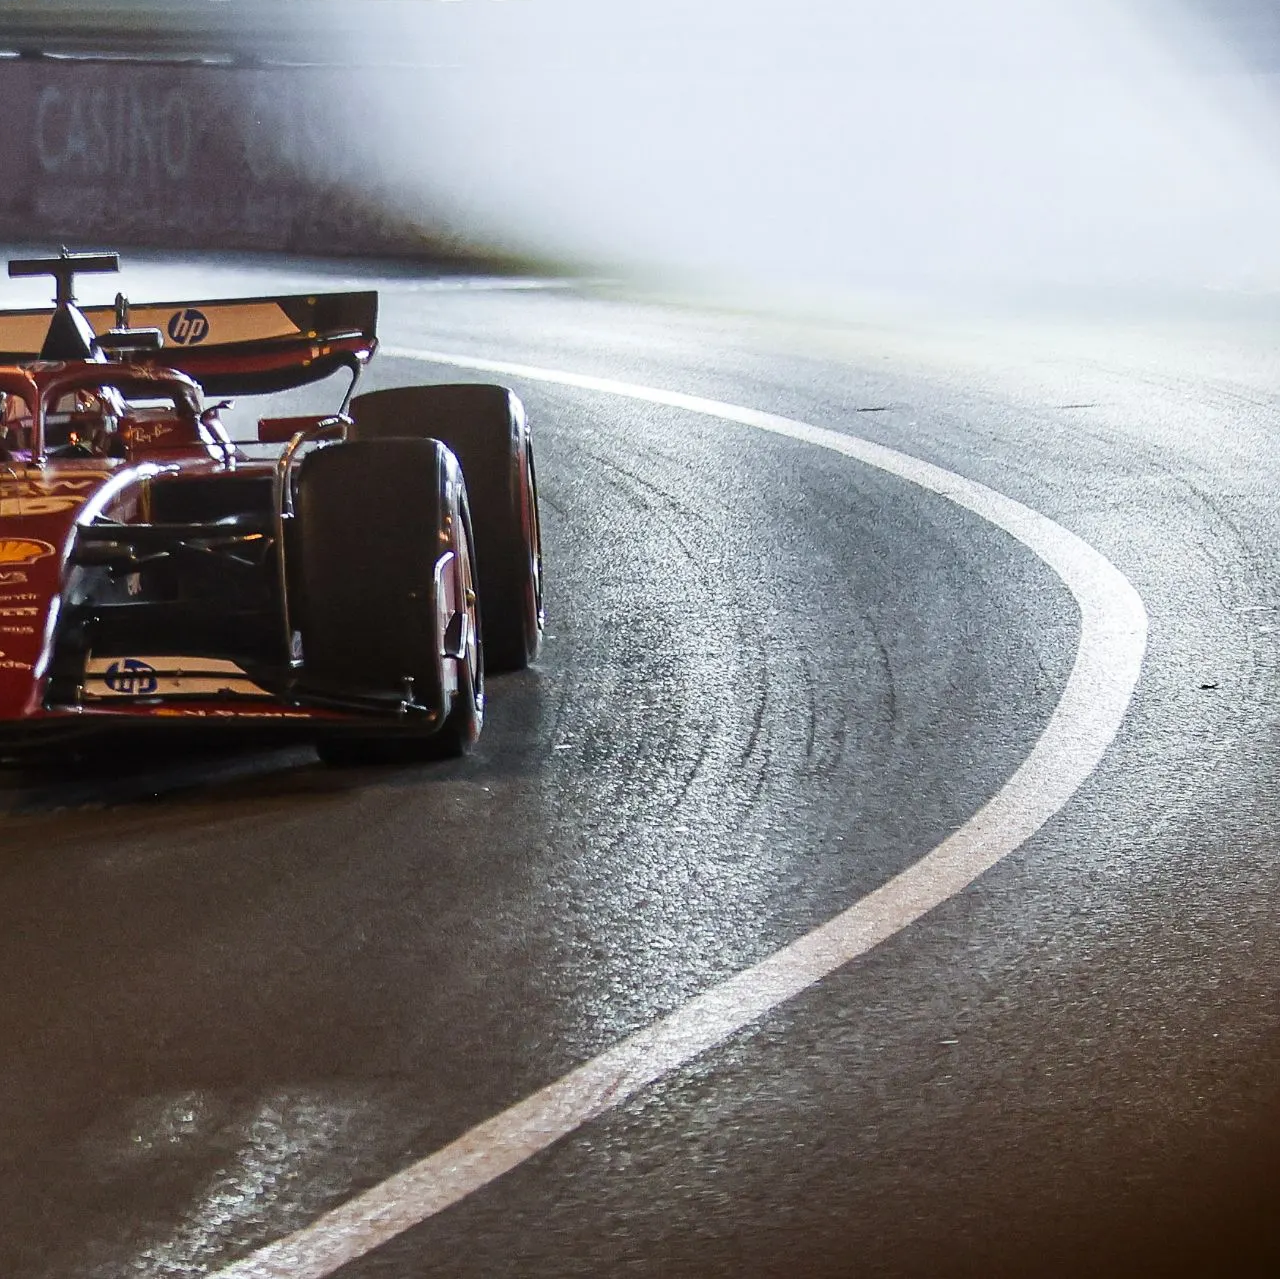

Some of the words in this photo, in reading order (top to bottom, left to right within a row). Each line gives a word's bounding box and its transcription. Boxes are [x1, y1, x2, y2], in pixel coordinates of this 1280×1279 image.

[36, 85, 192, 180] CASINO
[173, 308, 206, 345] hp
[114, 658, 152, 696] hp
